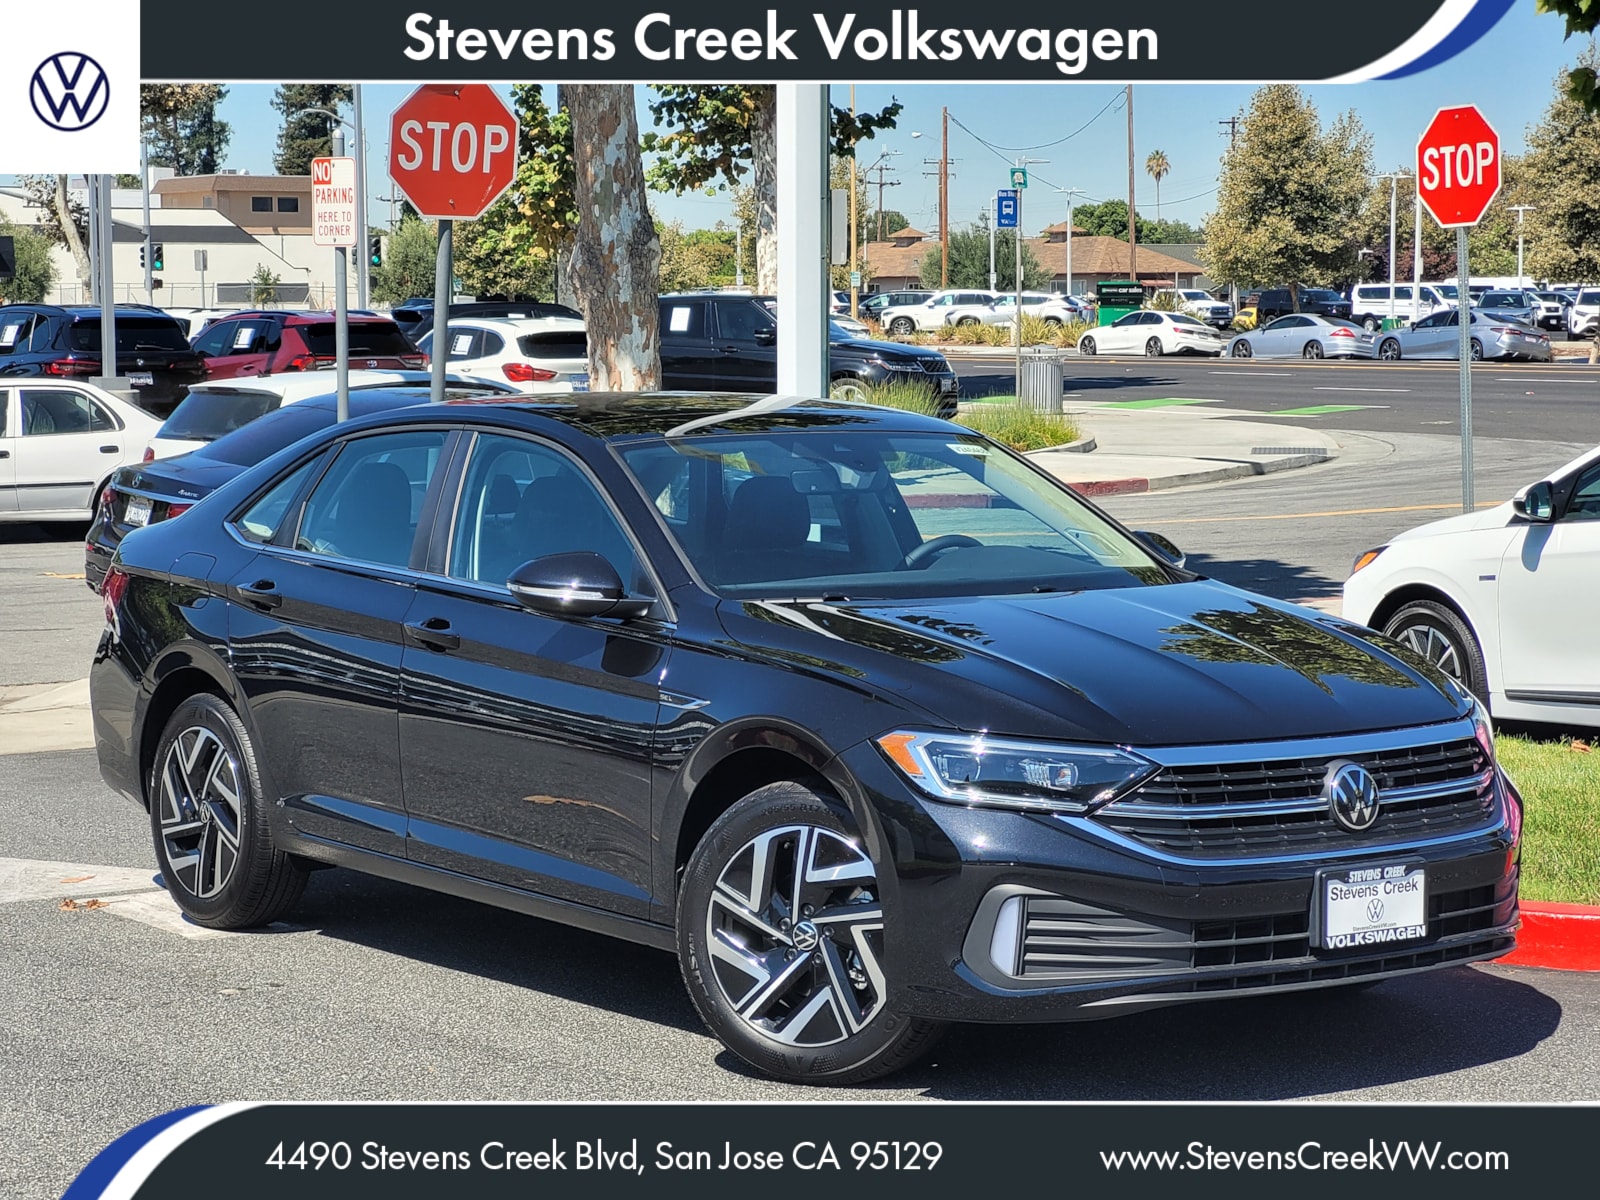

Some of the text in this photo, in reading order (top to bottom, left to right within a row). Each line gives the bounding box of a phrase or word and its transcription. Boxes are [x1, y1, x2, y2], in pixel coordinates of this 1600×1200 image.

[398, 120, 509, 173] STOP
[314, 162, 331, 181] NO
[1422, 142, 1494, 191] STOP
[316, 187, 353, 204] PARKING
[318, 211, 352, 222] HERE TO
[319, 225, 350, 236] CORNER
[1349, 865, 1406, 883] STEVENS CREEK
[1330, 878, 1418, 901] Stevens Creek
[1326, 925, 1426, 949] VOLKSWAGEN
